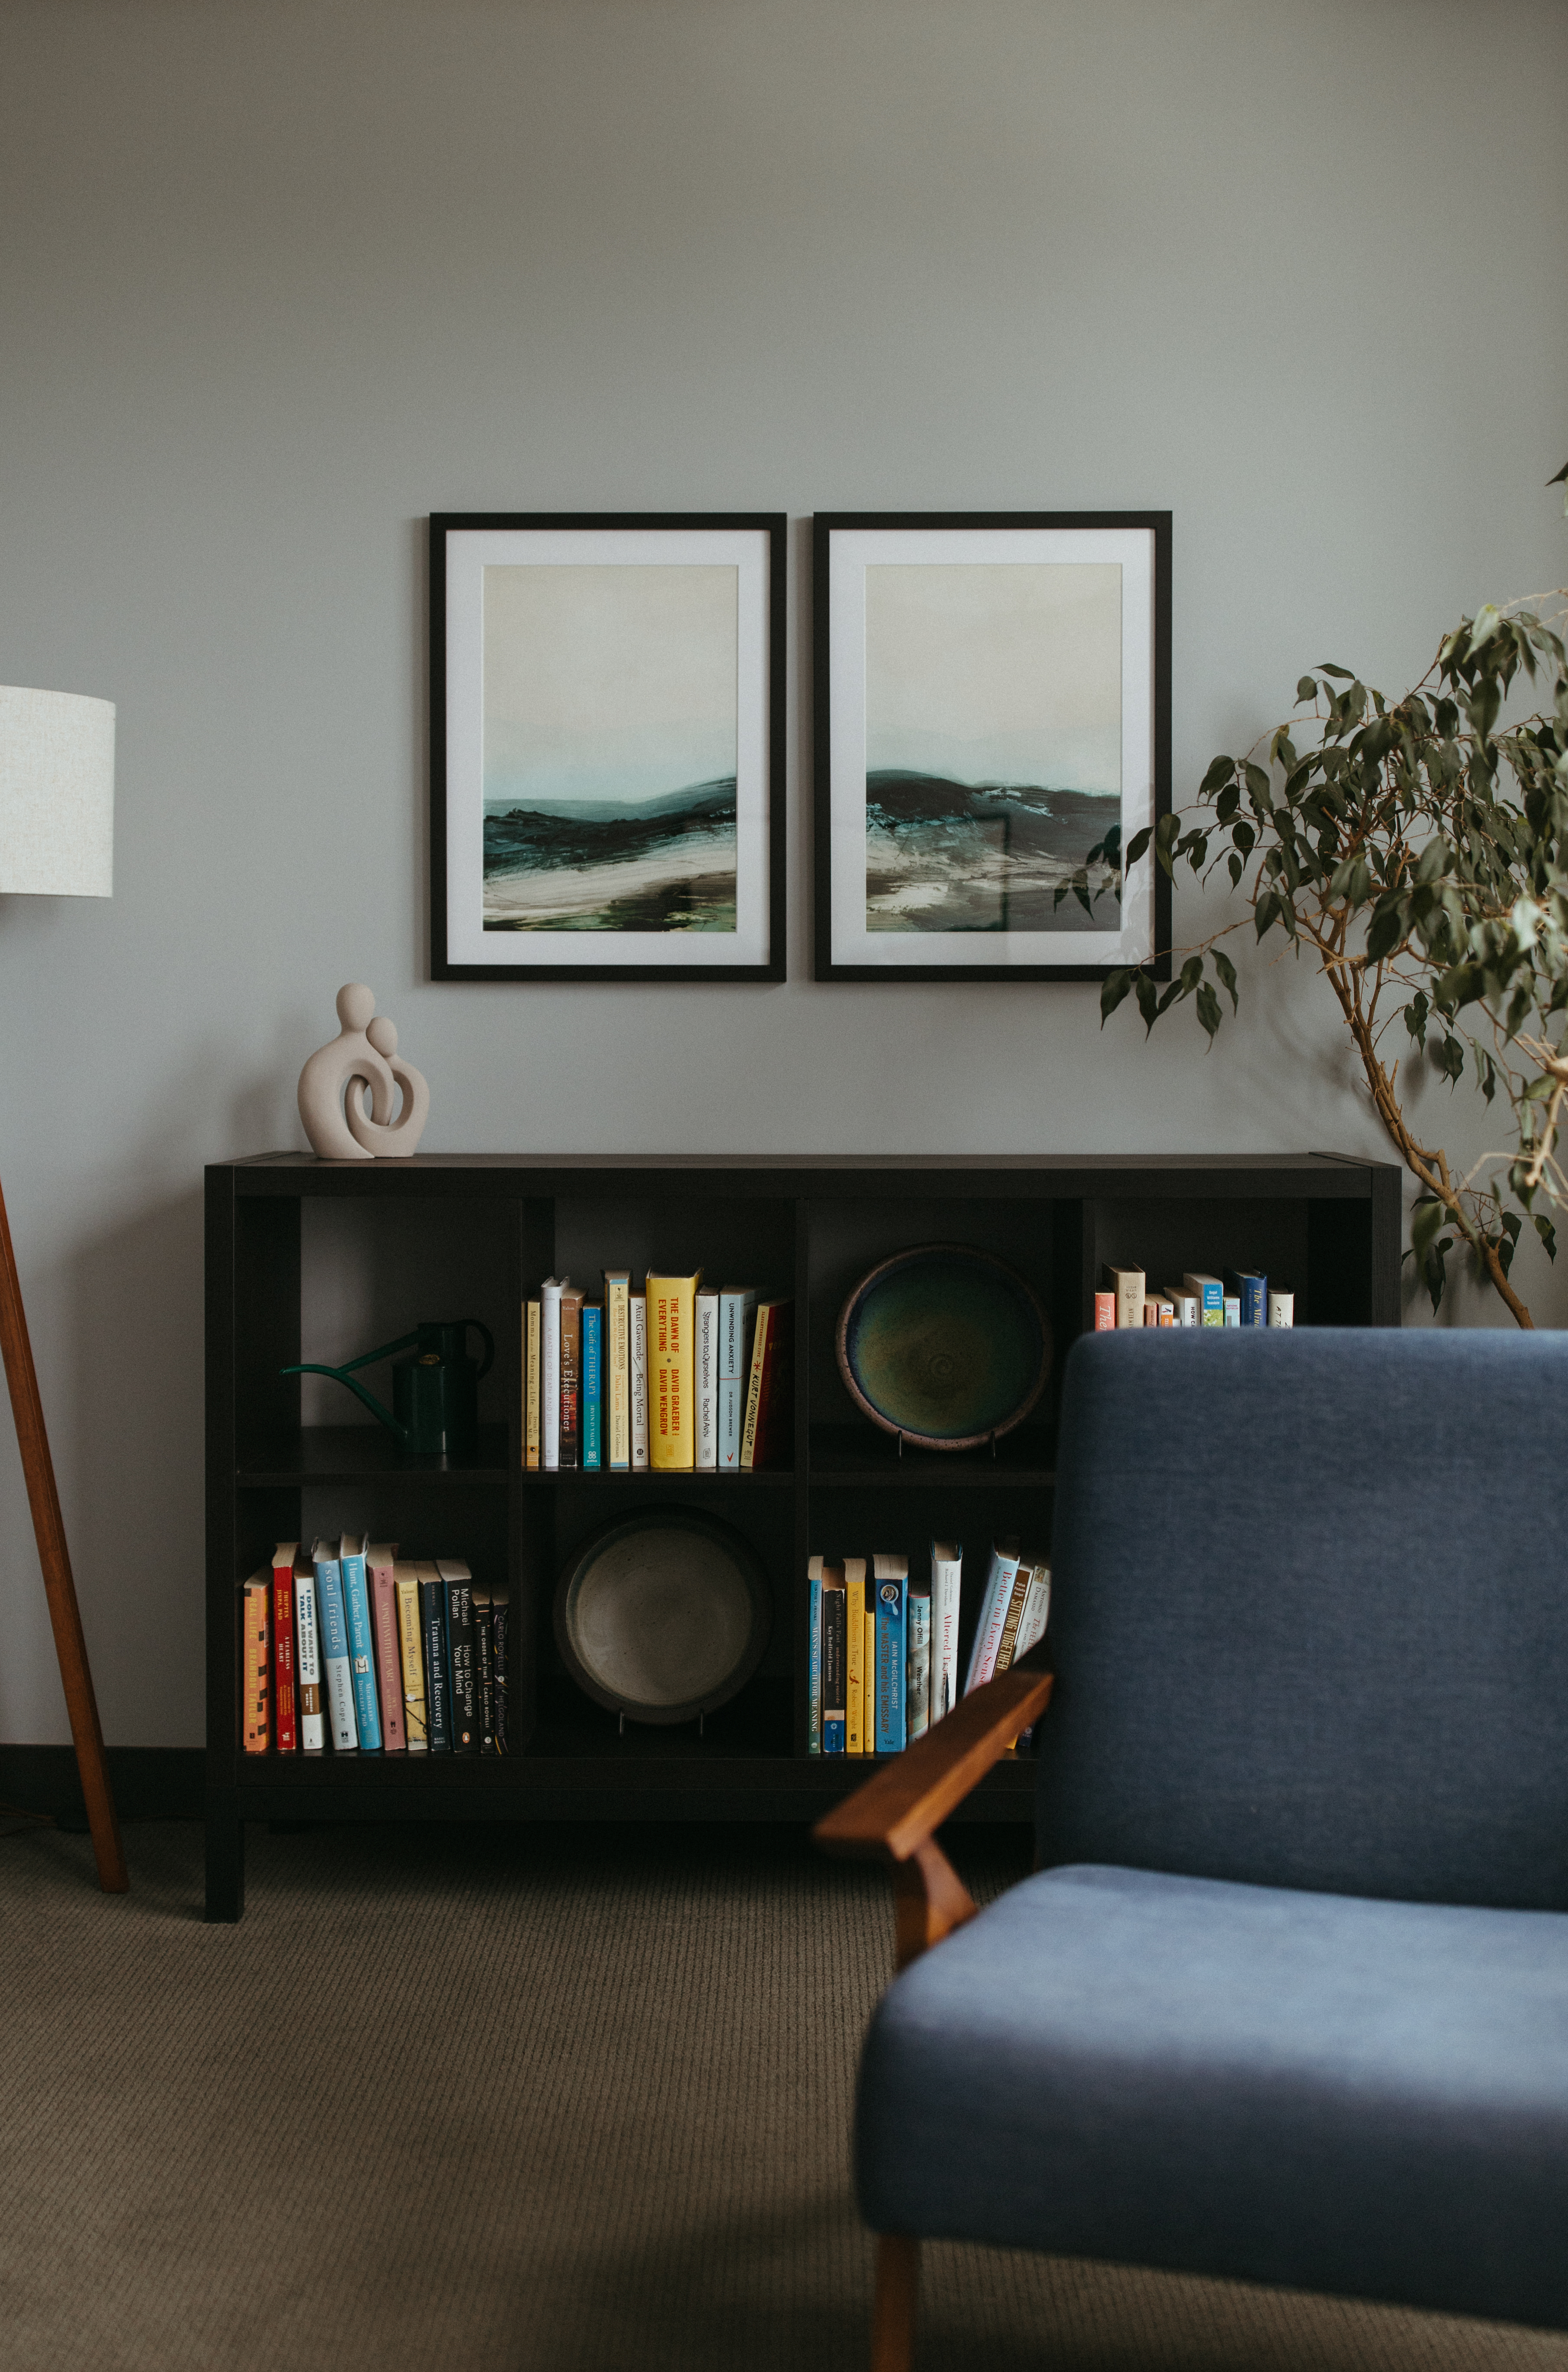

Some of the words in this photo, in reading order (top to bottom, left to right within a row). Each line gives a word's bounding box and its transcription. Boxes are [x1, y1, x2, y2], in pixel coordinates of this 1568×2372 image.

[671, 1297, 679, 1314] THE
[1275, 1306, 1281, 1318] AT
[658, 1299, 667, 1352] EVERYTHING
[671, 1317, 679, 1340] DAWN
[702, 1311, 711, 1344] Strangers
[564, 1334, 573, 1365] Love's
[589, 1346, 596, 1354] of
[671, 1343, 679, 1353] OF
[547, 1361, 553, 1370] OF
[634, 1374, 643, 1396] Being
[751, 1374, 760, 1398] KURT
[563, 1370, 573, 1431] Executioner
[672, 1395, 680, 1431] GRAEBER
[659, 1395, 668, 1436] WENGROW
[746, 1399, 757, 1446] VONNEGUT
[703, 1422, 711, 1438] Aviv
[325, 1569, 336, 1596] soul
[349, 1563, 358, 1588] Hunt,
[997, 1571, 1012, 1604] Better
[249, 1597, 257, 1617] REAL
[351, 1589, 362, 1620] Gather,
[452, 1589, 460, 1618] Pollan
[460, 1588, 470, 1626] Michael
[1031, 1587, 1041, 1611] DAMASIO
[1037, 1589, 1047, 1613] ANTONIO
[994, 1608, 1004, 1618] in
[1006, 1599, 1023, 1630] SITTING
[1032, 1618, 1040, 1630] The
[249, 1622, 257, 1639] LIFE
[328, 1603, 341, 1650] friends
[354, 1622, 363, 1648] Parent
[943, 1613, 952, 1650] Altered
[984, 1622, 1001, 1650] Every
[407, 1646, 417, 1676] Myself
[454, 1645, 462, 1667] Your
[463, 1645, 471, 1666] How
[996, 1631, 1016, 1670] TOGETHER
[249, 1648, 257, 1688] BRANDON
[302, 1662, 307, 1671] IT
[309, 1661, 314, 1675] TO
[433, 1661, 443, 1679] and
[464, 1669, 471, 1678] to
[455, 1670, 464, 1694] Mind
[248, 1693, 257, 1723] TAYLOR
[433, 1682, 443, 1729] Recovery
[464, 1681, 473, 1717] Change
[880, 1694, 889, 1733] EMISSARY
